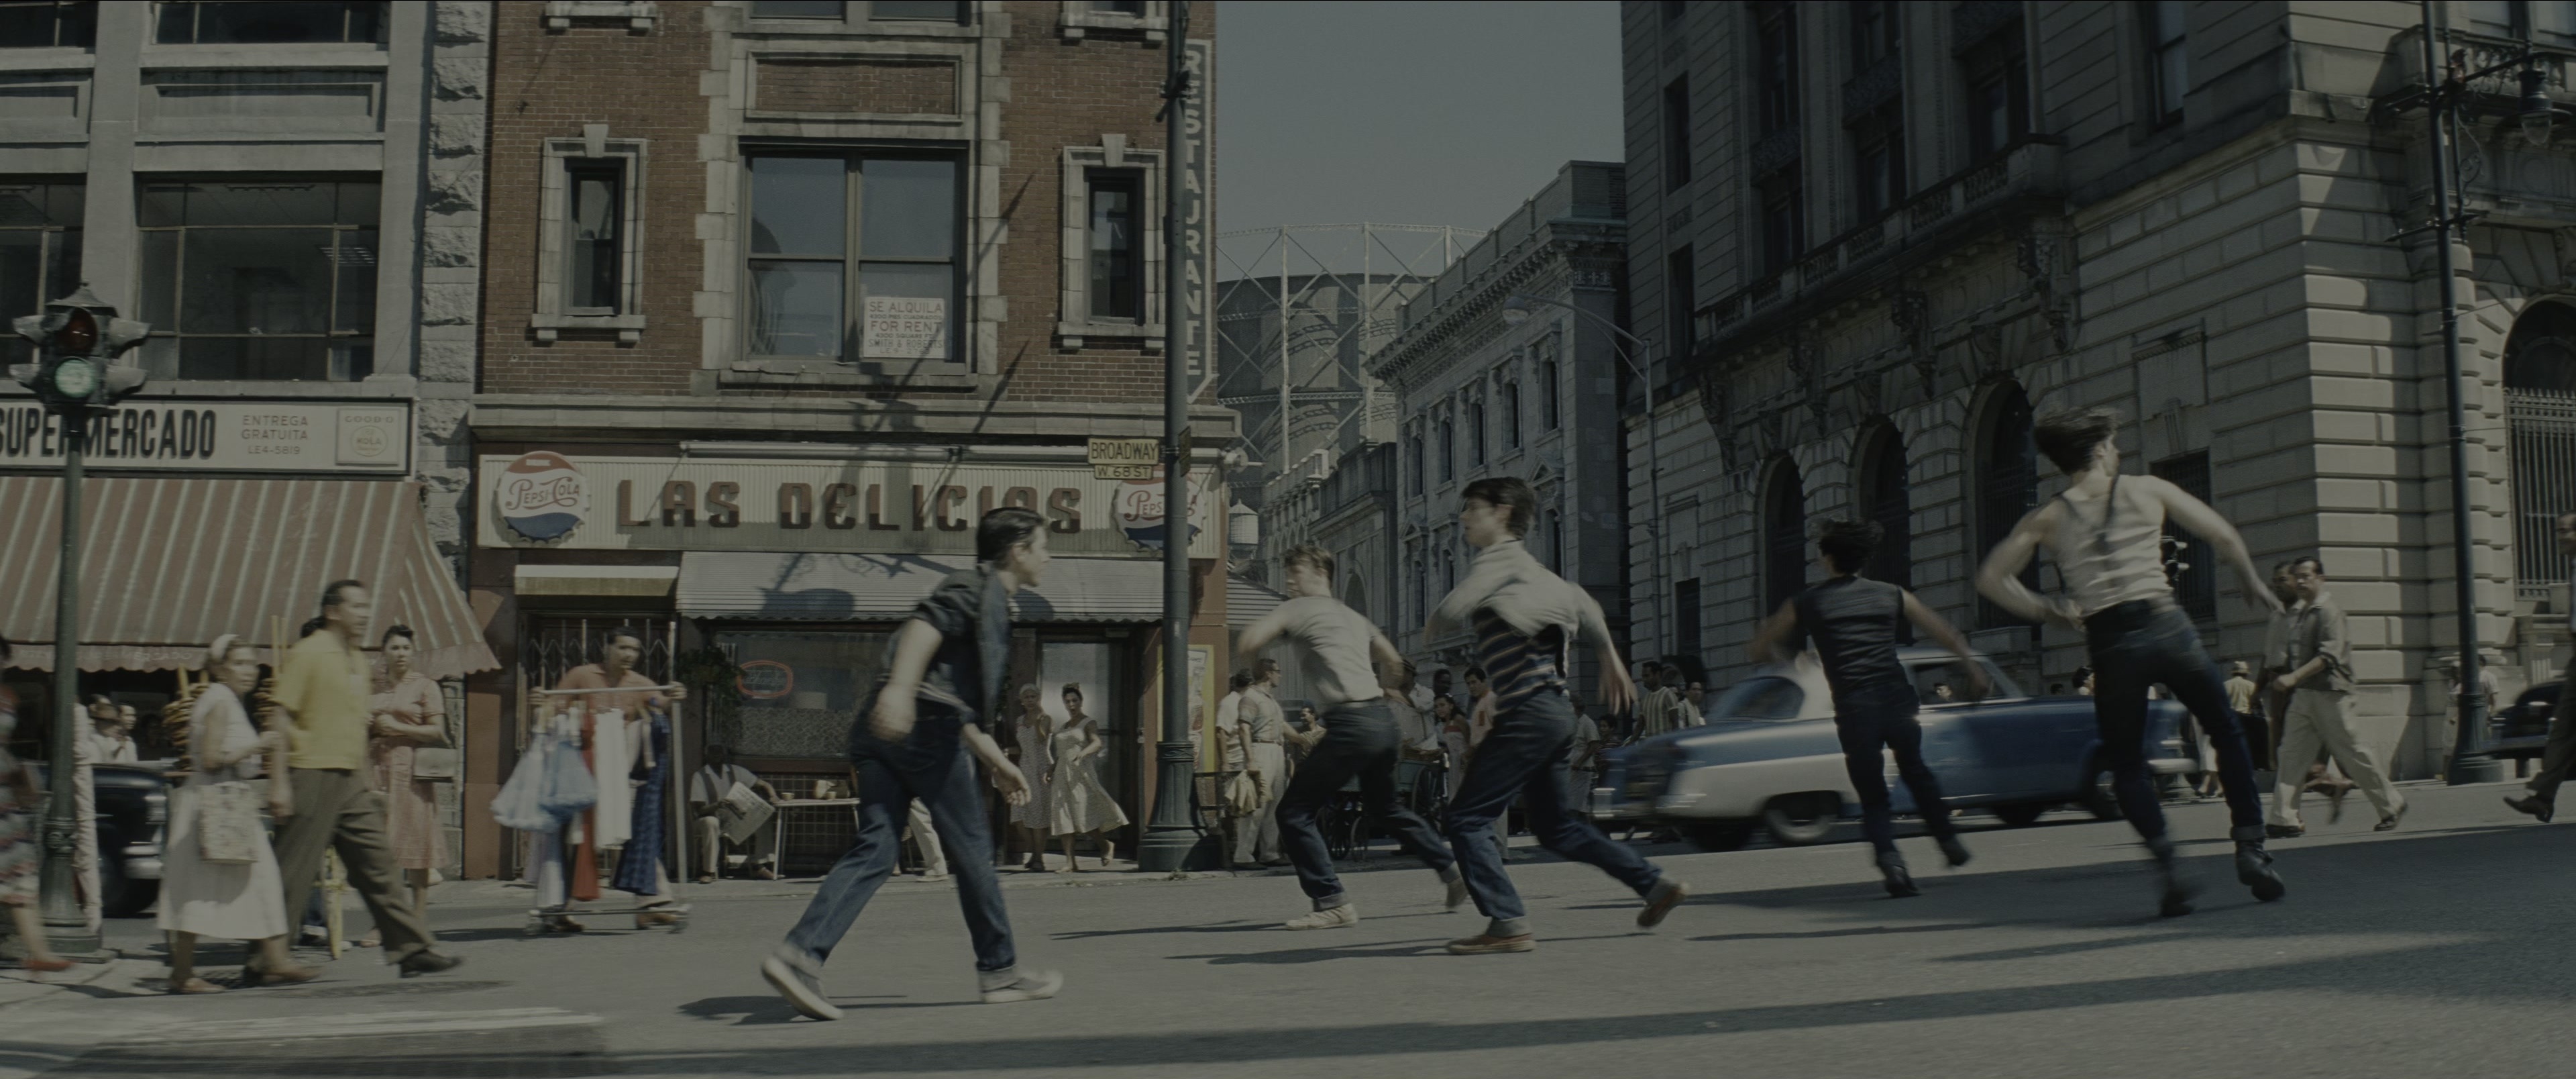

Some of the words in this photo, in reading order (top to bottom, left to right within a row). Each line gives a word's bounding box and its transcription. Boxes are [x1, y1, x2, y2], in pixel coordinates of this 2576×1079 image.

[869, 301, 885, 312] SE
[888, 302, 943, 313] ALQUILA
[871, 320, 899, 331] FOR
[904, 321, 943, 332] RENT
[869, 339, 894, 348] SMITH
[897, 340, 903, 348] &
[906, 339, 943, 349] ROBERTS
[242, 415, 309, 426] ENTREGA
[0, 407, 218, 460] UPEMERCADO
[241, 429, 308, 440] GRATUITA
[357, 437, 382, 446] KOLA
[248, 445, 301, 455] LE4-5819
[1091, 442, 1159, 460] BROADWAY
[1113, 466, 1131, 477] 68
[1134, 467, 1150, 478] ST
[620, 479, 741, 528] LAS
